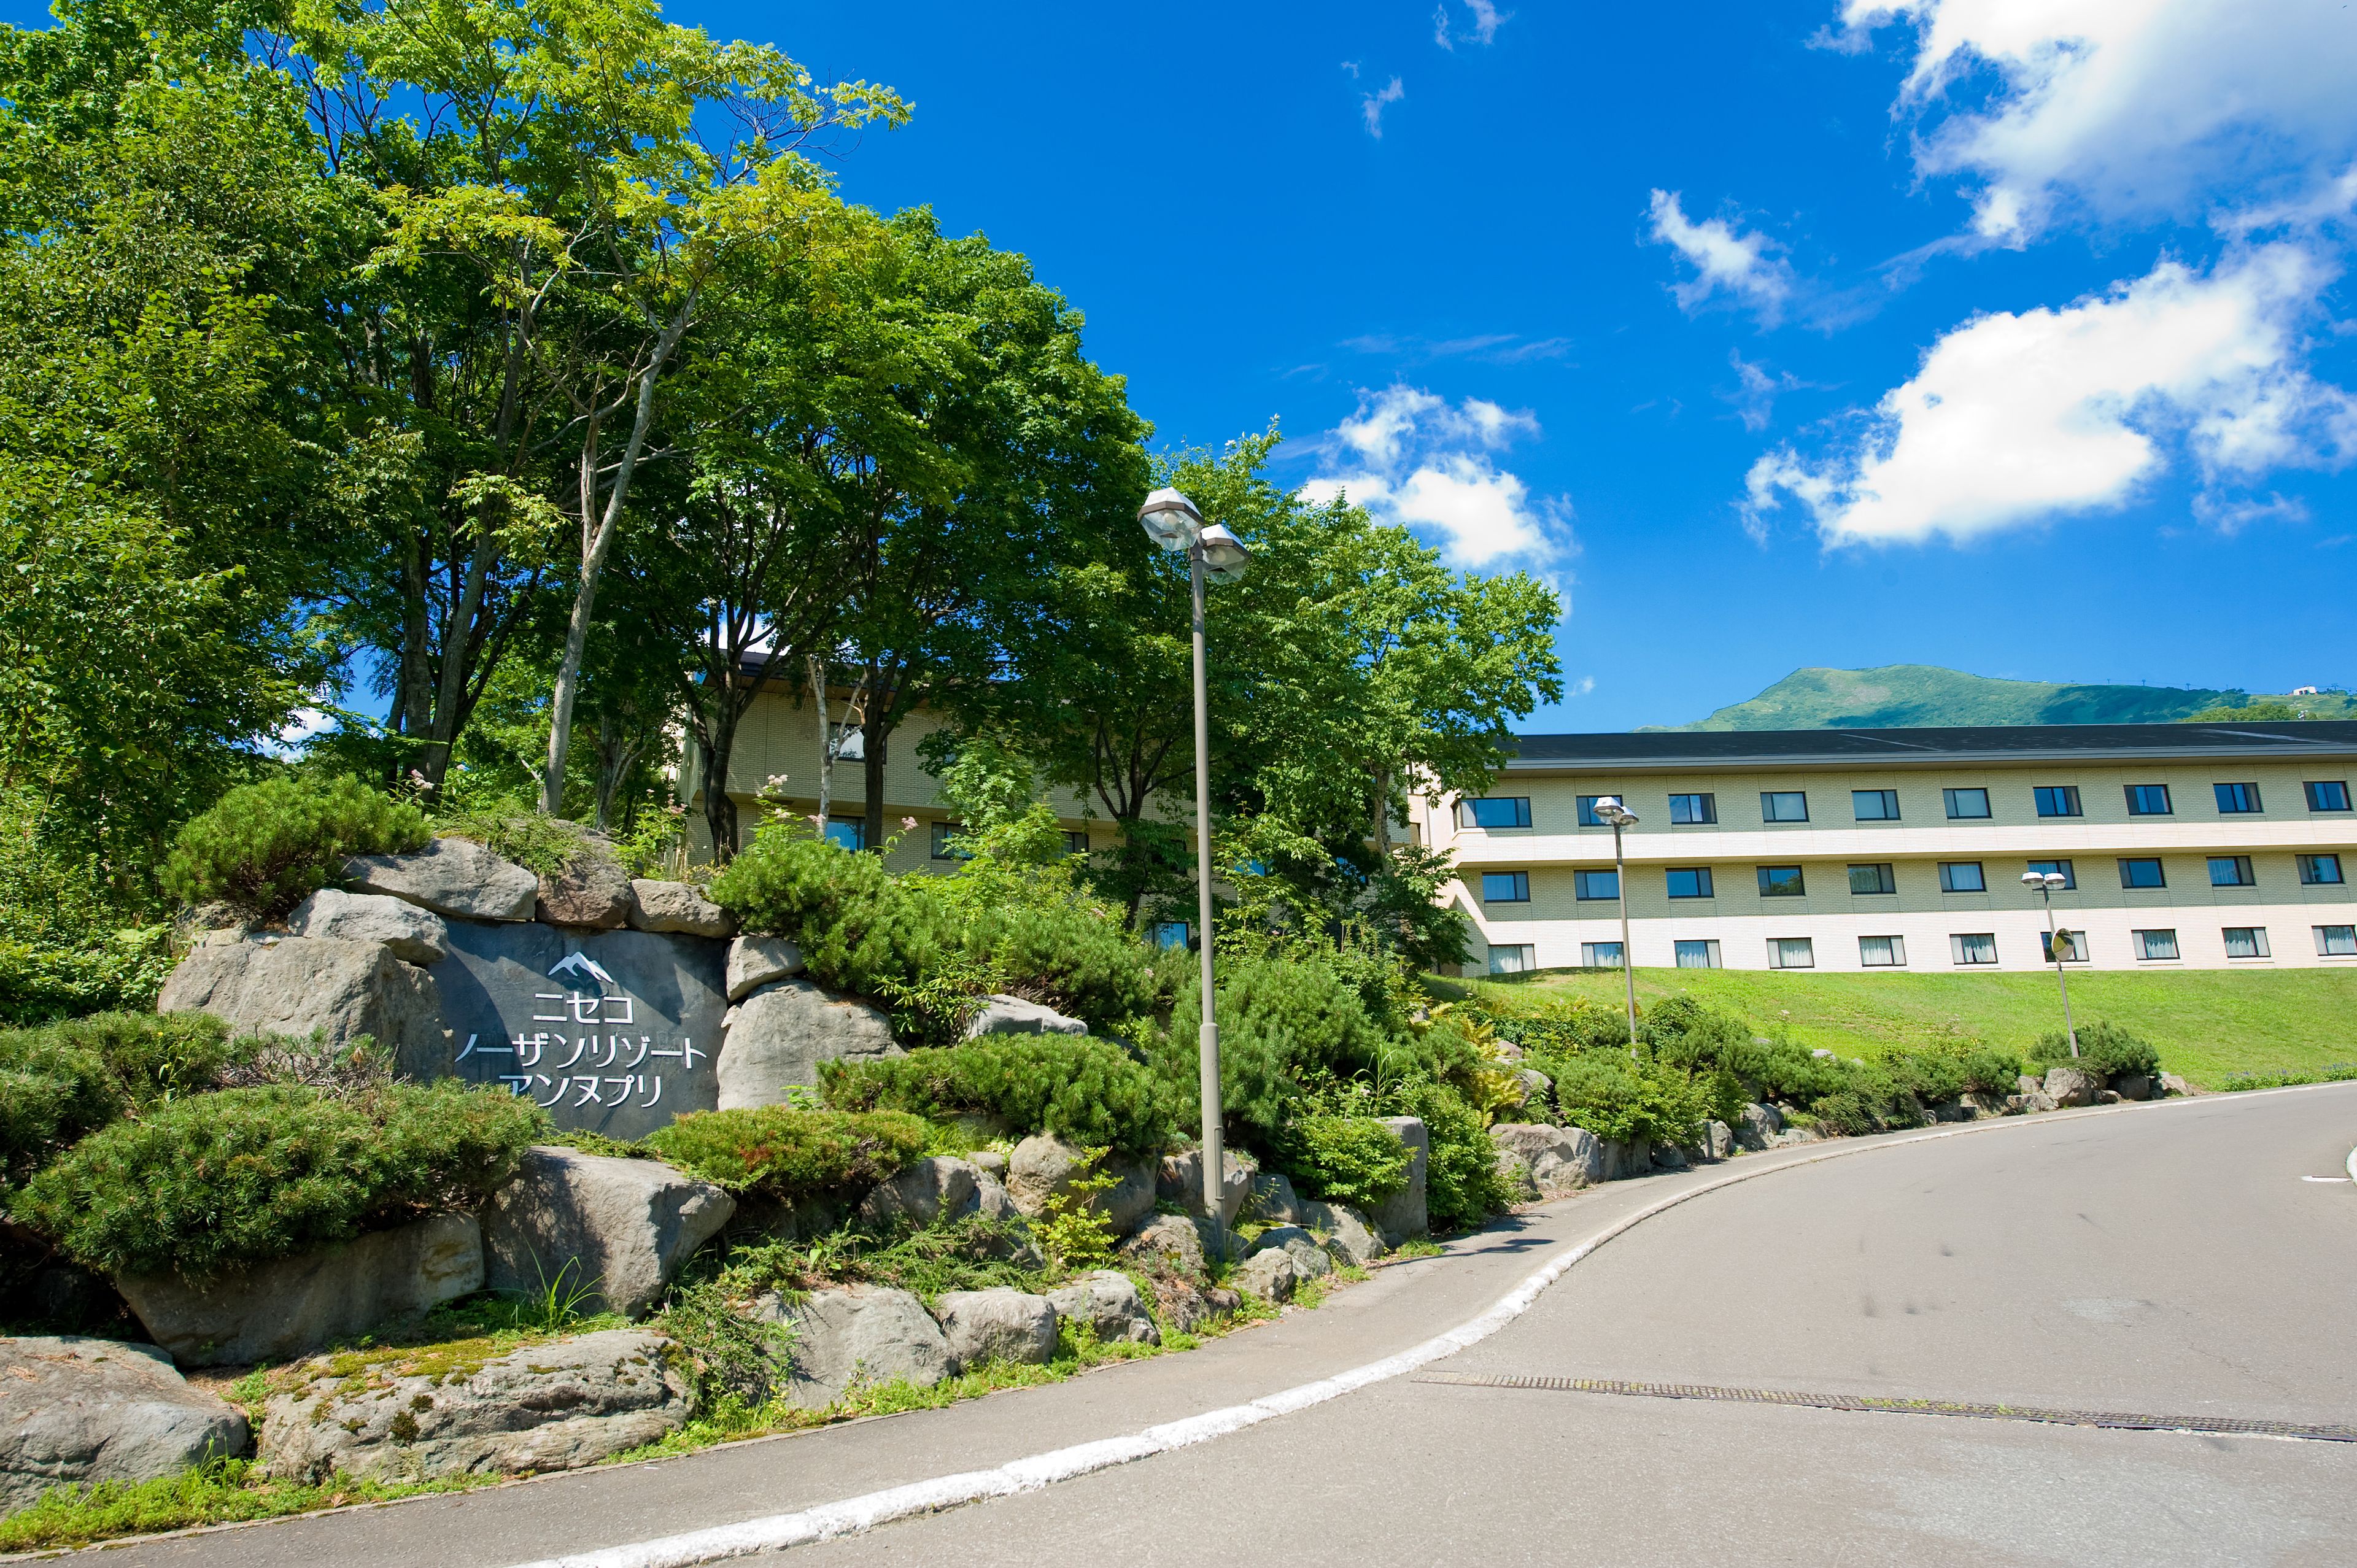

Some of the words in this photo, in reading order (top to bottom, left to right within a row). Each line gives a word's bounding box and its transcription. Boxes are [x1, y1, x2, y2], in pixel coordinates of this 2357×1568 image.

[533, 991, 634, 1024] ニセコ
[454, 1032, 707, 1069] ノーザンリゾート
[499, 1074, 661, 1108] アンヌプリ
